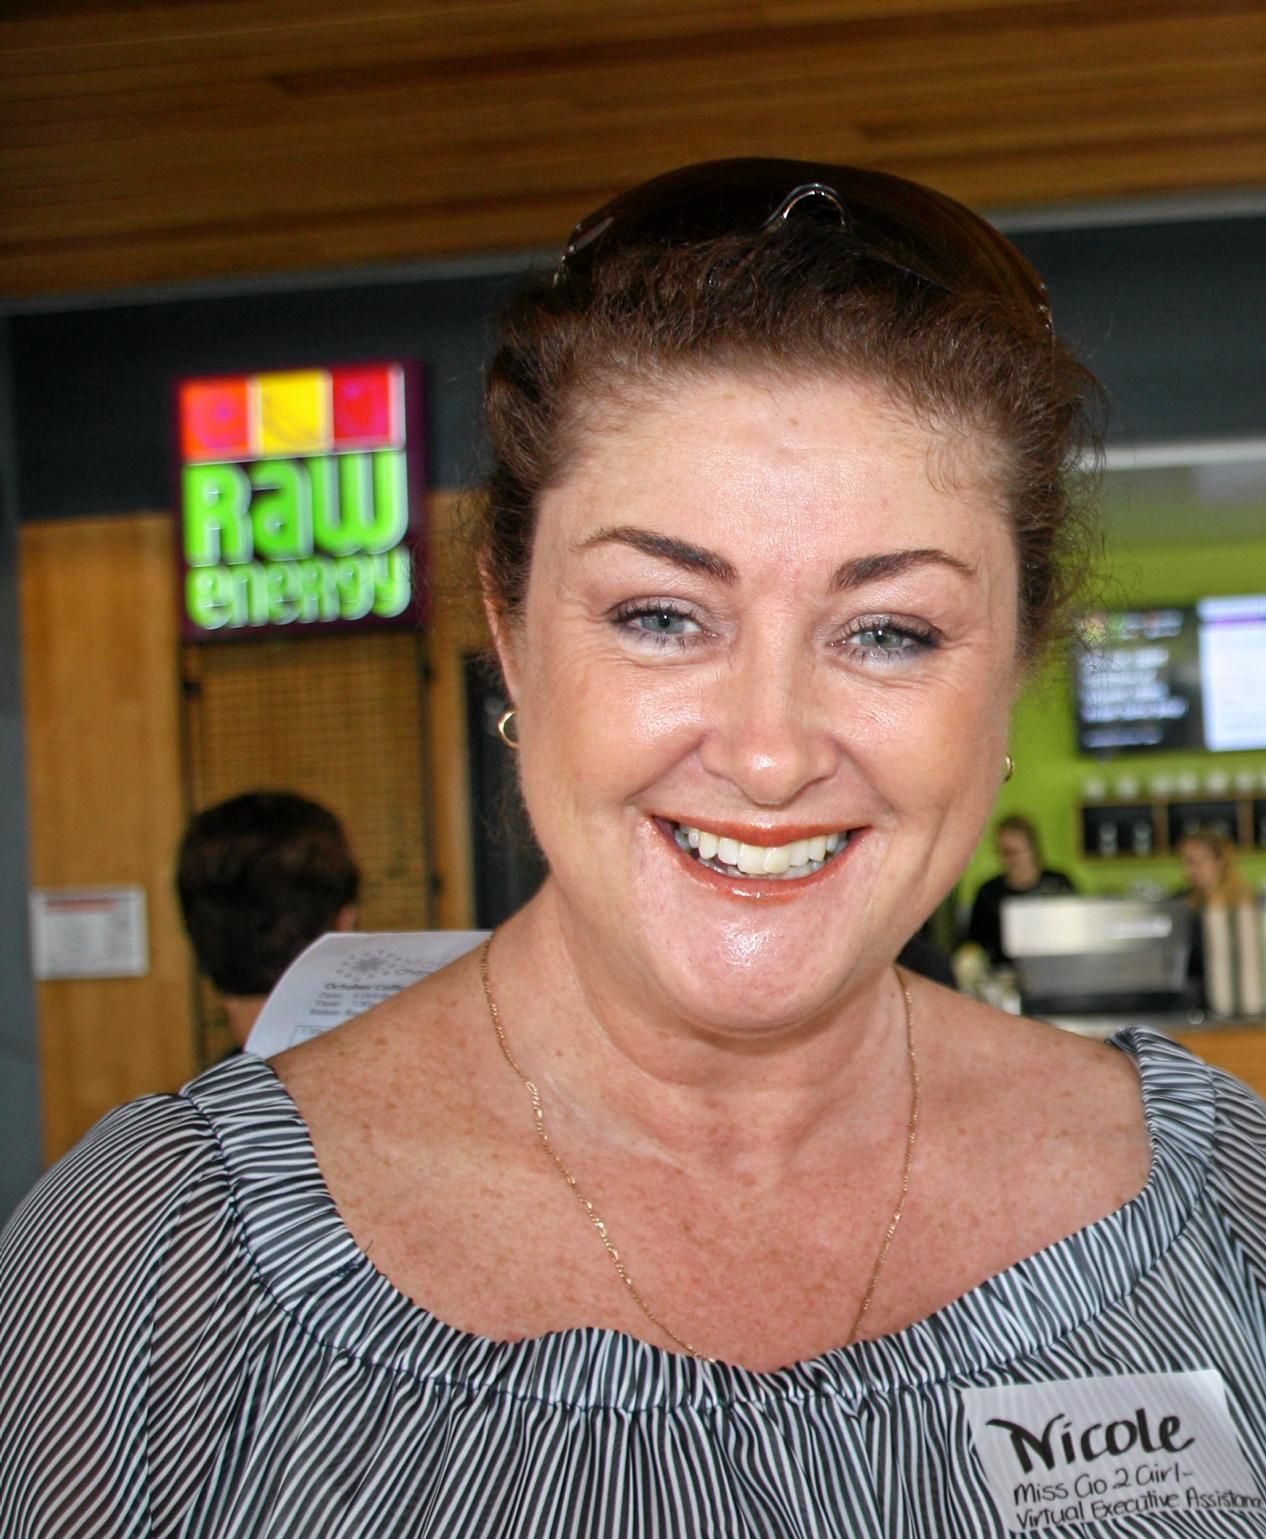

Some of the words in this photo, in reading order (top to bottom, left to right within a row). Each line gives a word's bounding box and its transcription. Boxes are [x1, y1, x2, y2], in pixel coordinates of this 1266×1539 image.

[986, 1408, 1195, 1474] Nicole
[1014, 1482, 1069, 1506] Miss
[1074, 1473, 1107, 1498] Go
[1113, 1467, 1131, 1489] 2
[1016, 1500, 1085, 1530] Virtual
[1090, 1490, 1179, 1521] Executive
